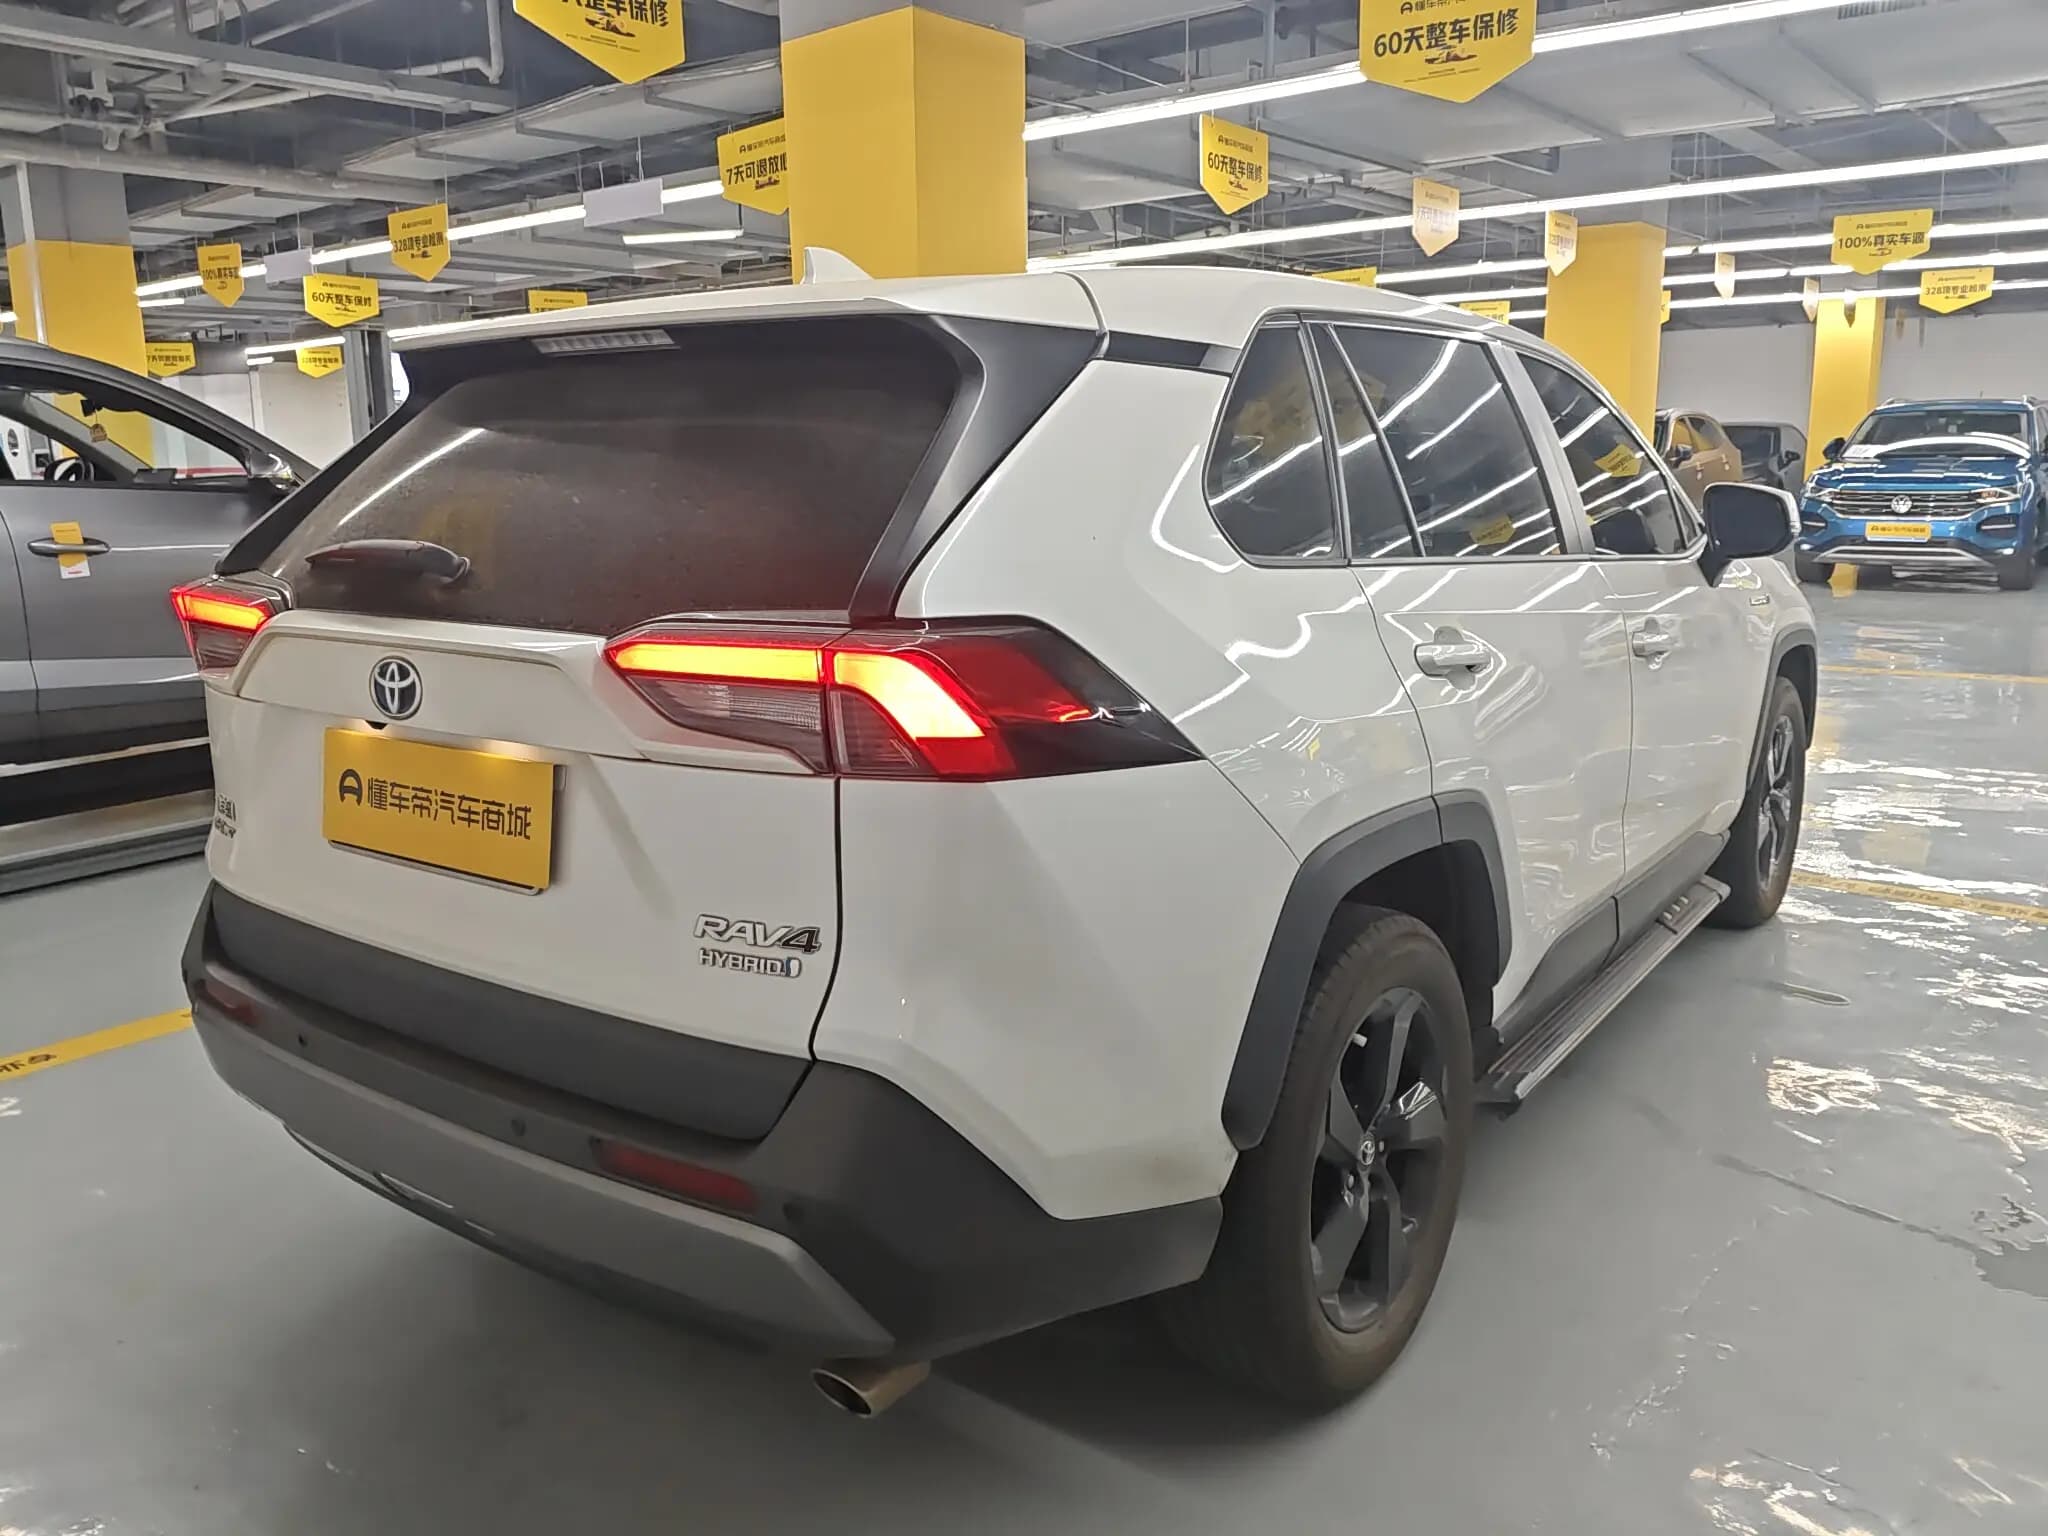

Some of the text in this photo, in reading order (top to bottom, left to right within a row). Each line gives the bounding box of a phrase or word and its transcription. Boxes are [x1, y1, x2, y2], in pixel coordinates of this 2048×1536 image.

[1374, 8, 1520, 58] 60天整车保修
[1207, 151, 1263, 184] 60天整车保修
[1838, 231, 1925, 249] 100%真实车源
[367, 776, 532, 841] 懂车帝汽车商城
[693, 913, 822, 955] RAV4
[699, 947, 786, 977] HYBRID
